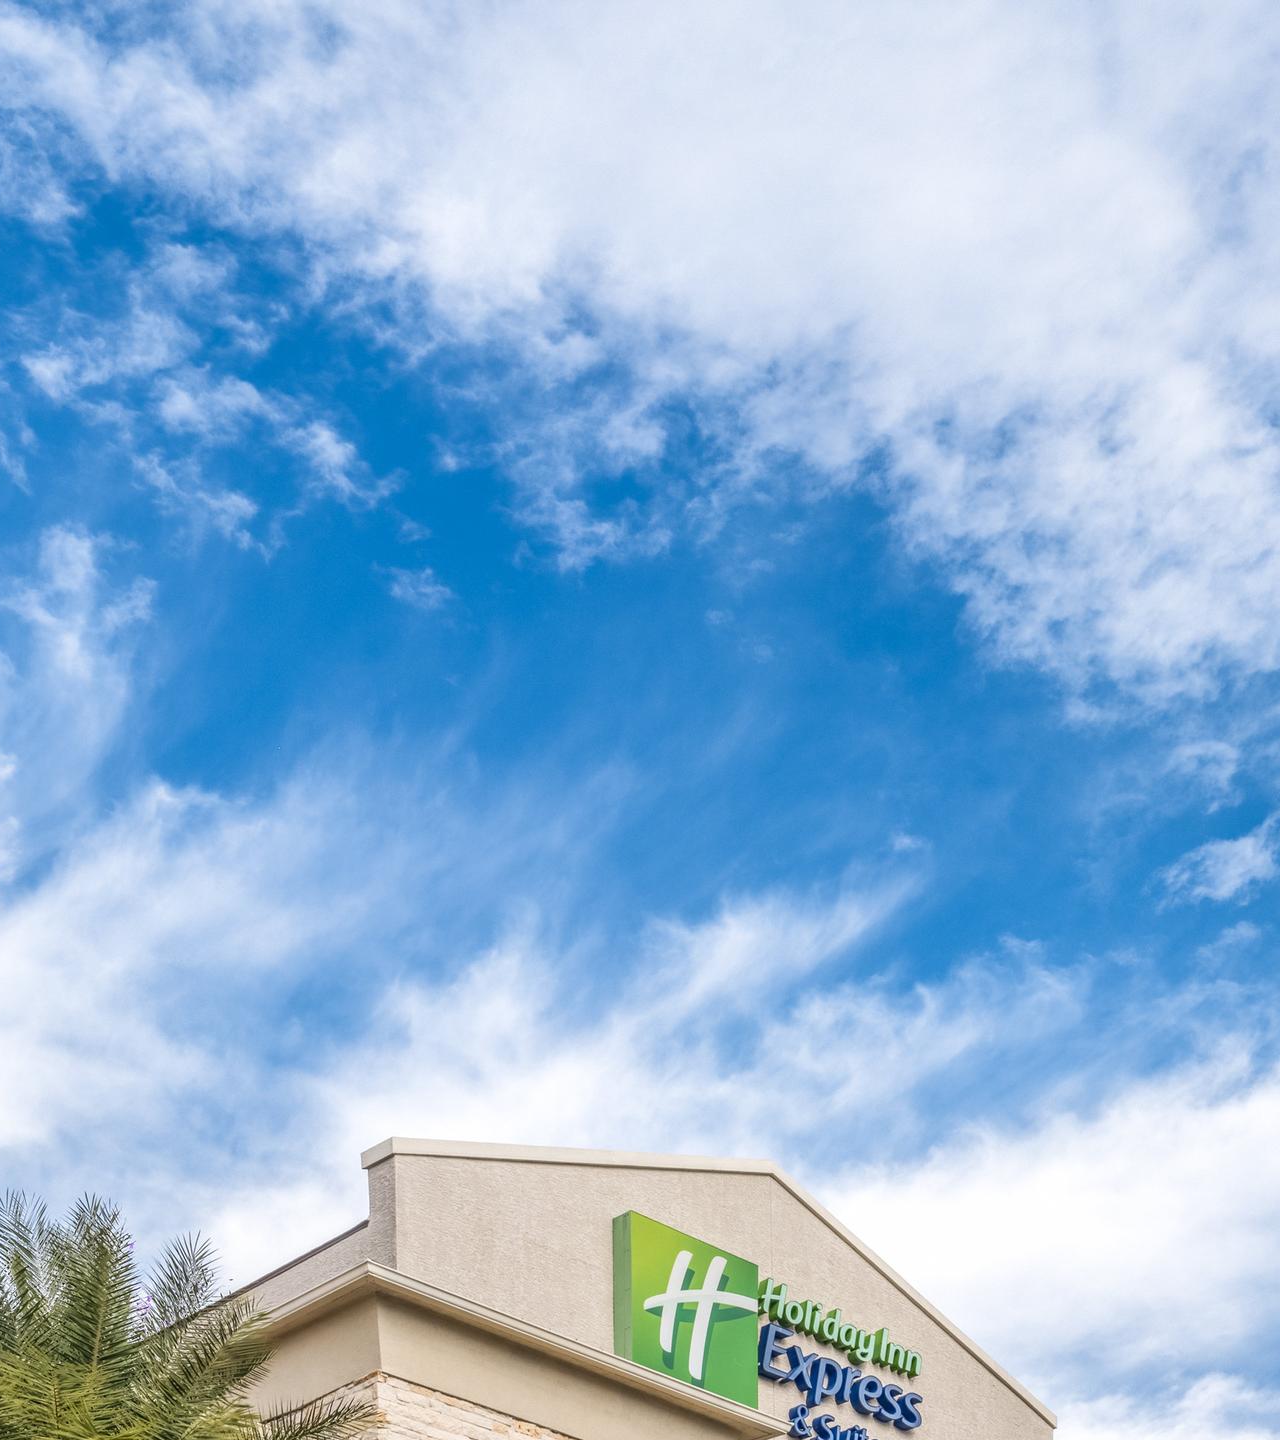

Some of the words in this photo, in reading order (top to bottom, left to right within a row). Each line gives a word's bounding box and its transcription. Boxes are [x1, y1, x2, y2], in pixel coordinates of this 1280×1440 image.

[758, 1278, 875, 1366] Holiday
[874, 1328, 922, 1379] Inn
[758, 1323, 924, 1431] Express
[787, 1404, 812, 1438] &
